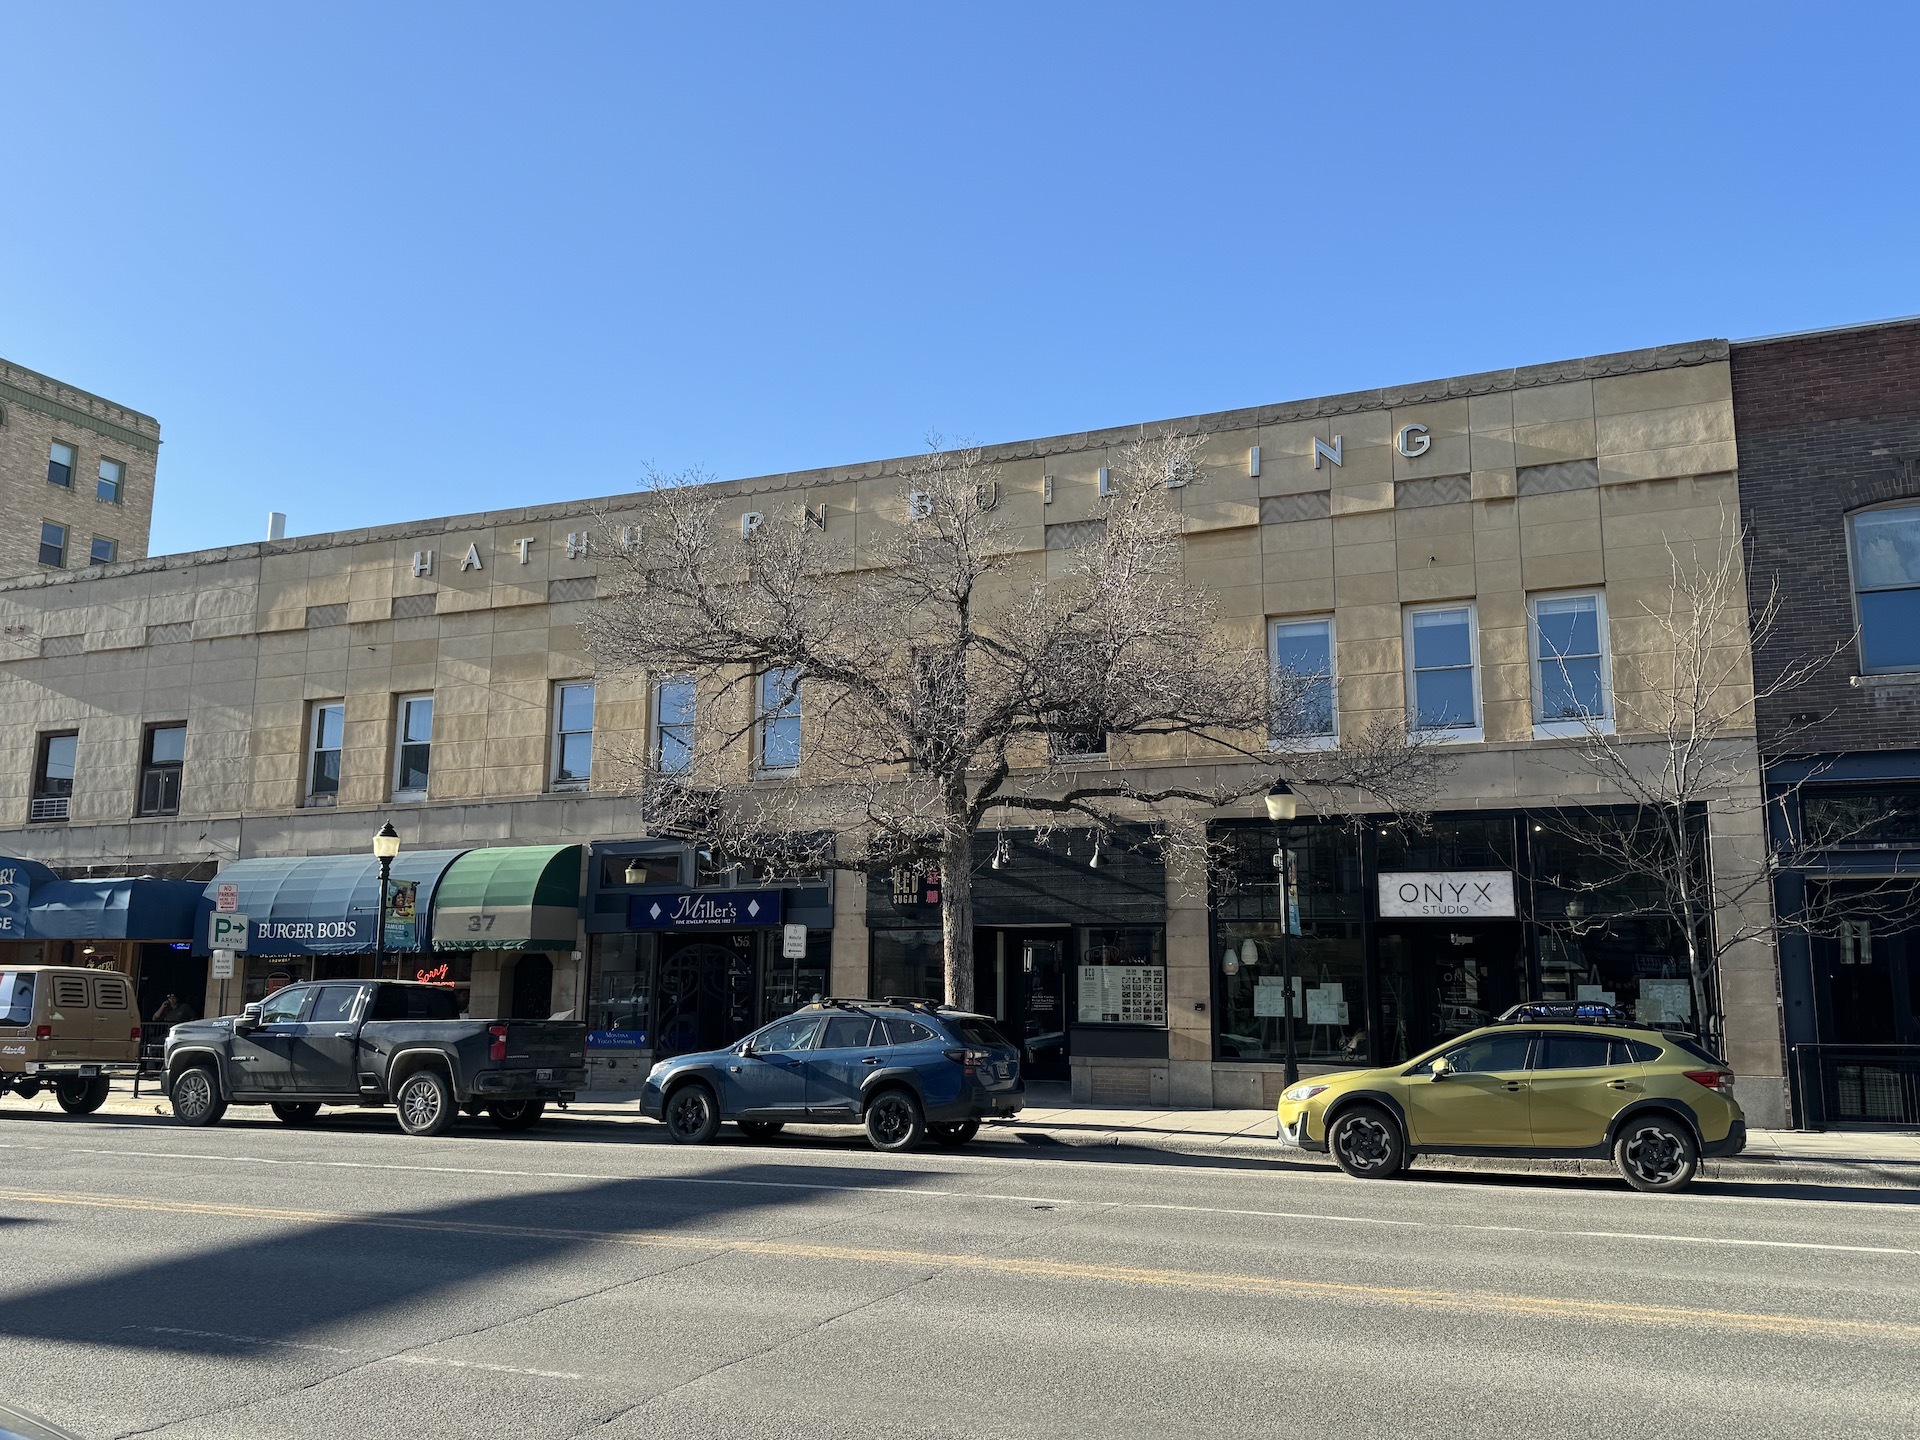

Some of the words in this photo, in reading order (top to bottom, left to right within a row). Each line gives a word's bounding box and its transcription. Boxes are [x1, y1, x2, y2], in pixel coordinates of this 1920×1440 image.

[410, 503, 826, 577] HATHHRN
[893, 894, 918, 904] SUGAR
[1399, 882, 1492, 903] ONYX
[670, 894, 737, 919] Miller's
[1422, 905, 1469, 915] STUDIO
[258, 922, 314, 939] BURGER
[317, 921, 357, 938] BOB'S
[467, 914, 496, 931] 37
[416, 963, 449, 983] Sorry
